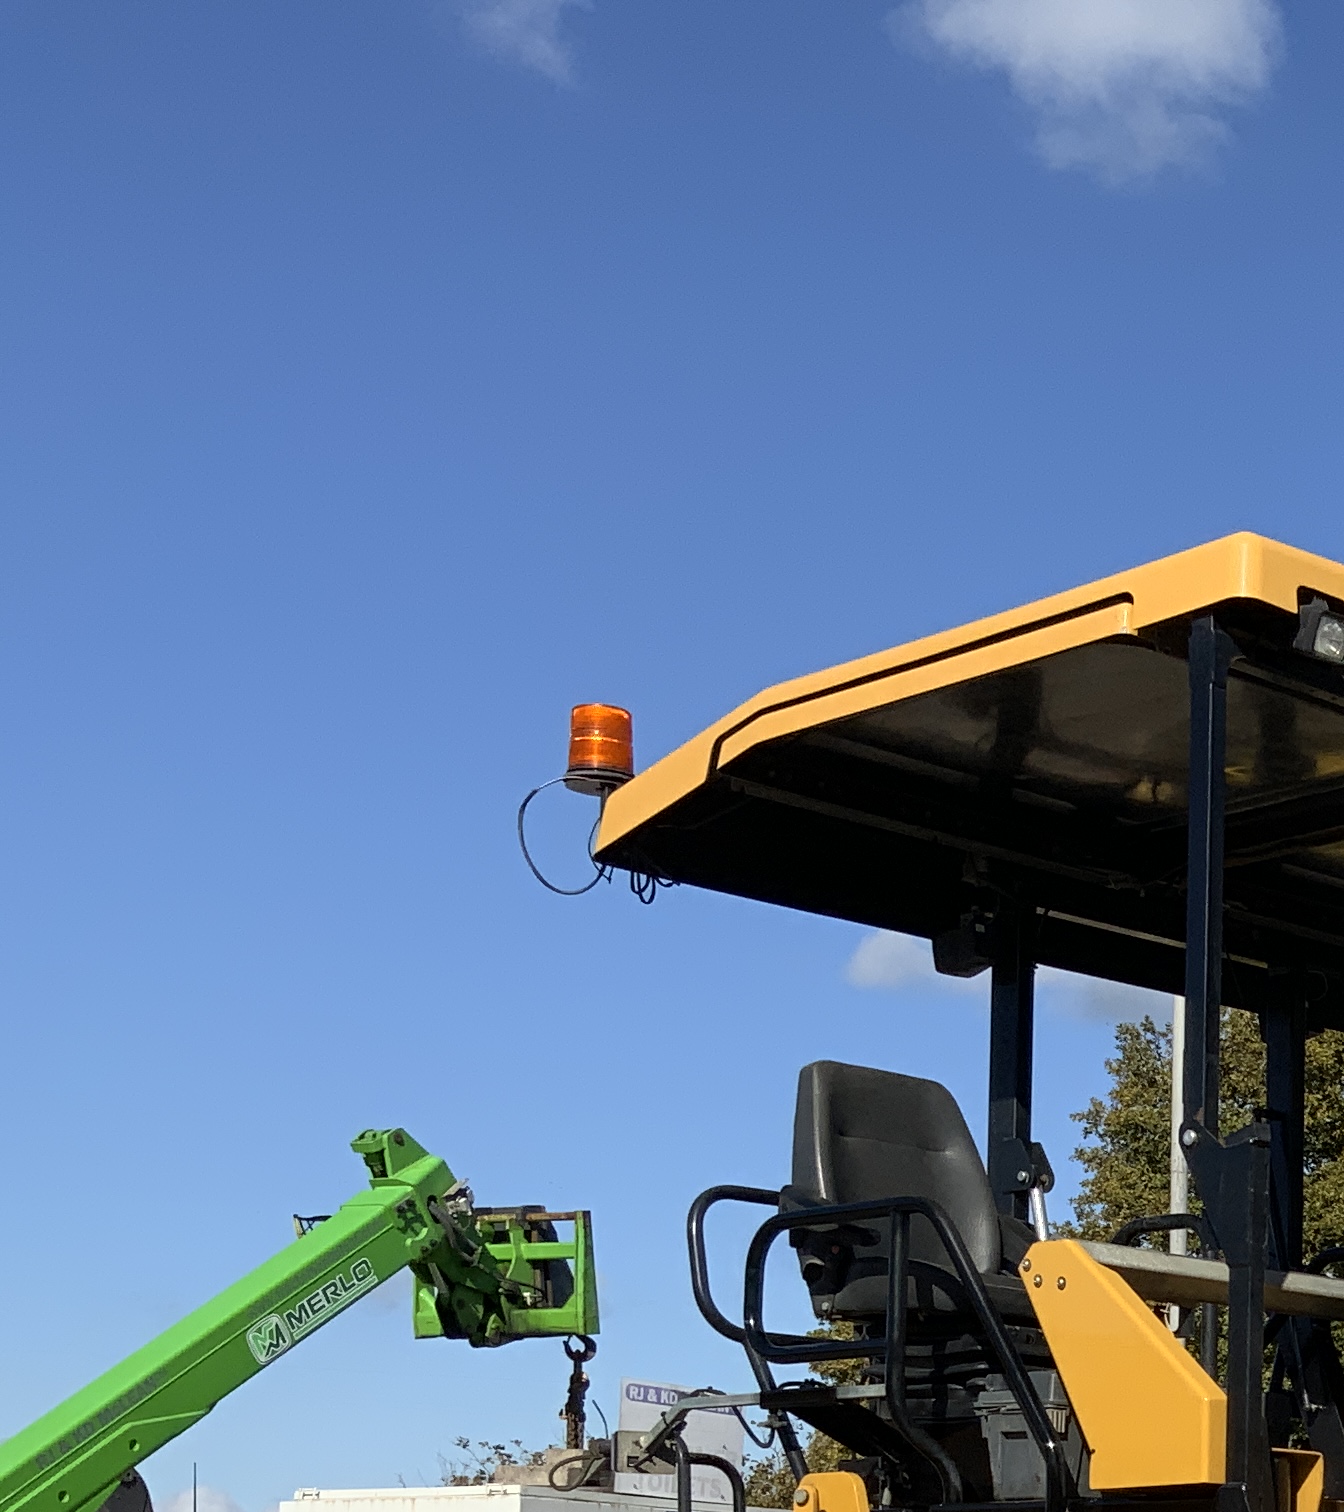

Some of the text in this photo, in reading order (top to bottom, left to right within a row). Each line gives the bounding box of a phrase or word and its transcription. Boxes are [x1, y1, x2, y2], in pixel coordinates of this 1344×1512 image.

[284, 1258, 374, 1332] MERLO
[629, 1385, 679, 1405] RJ & KD
